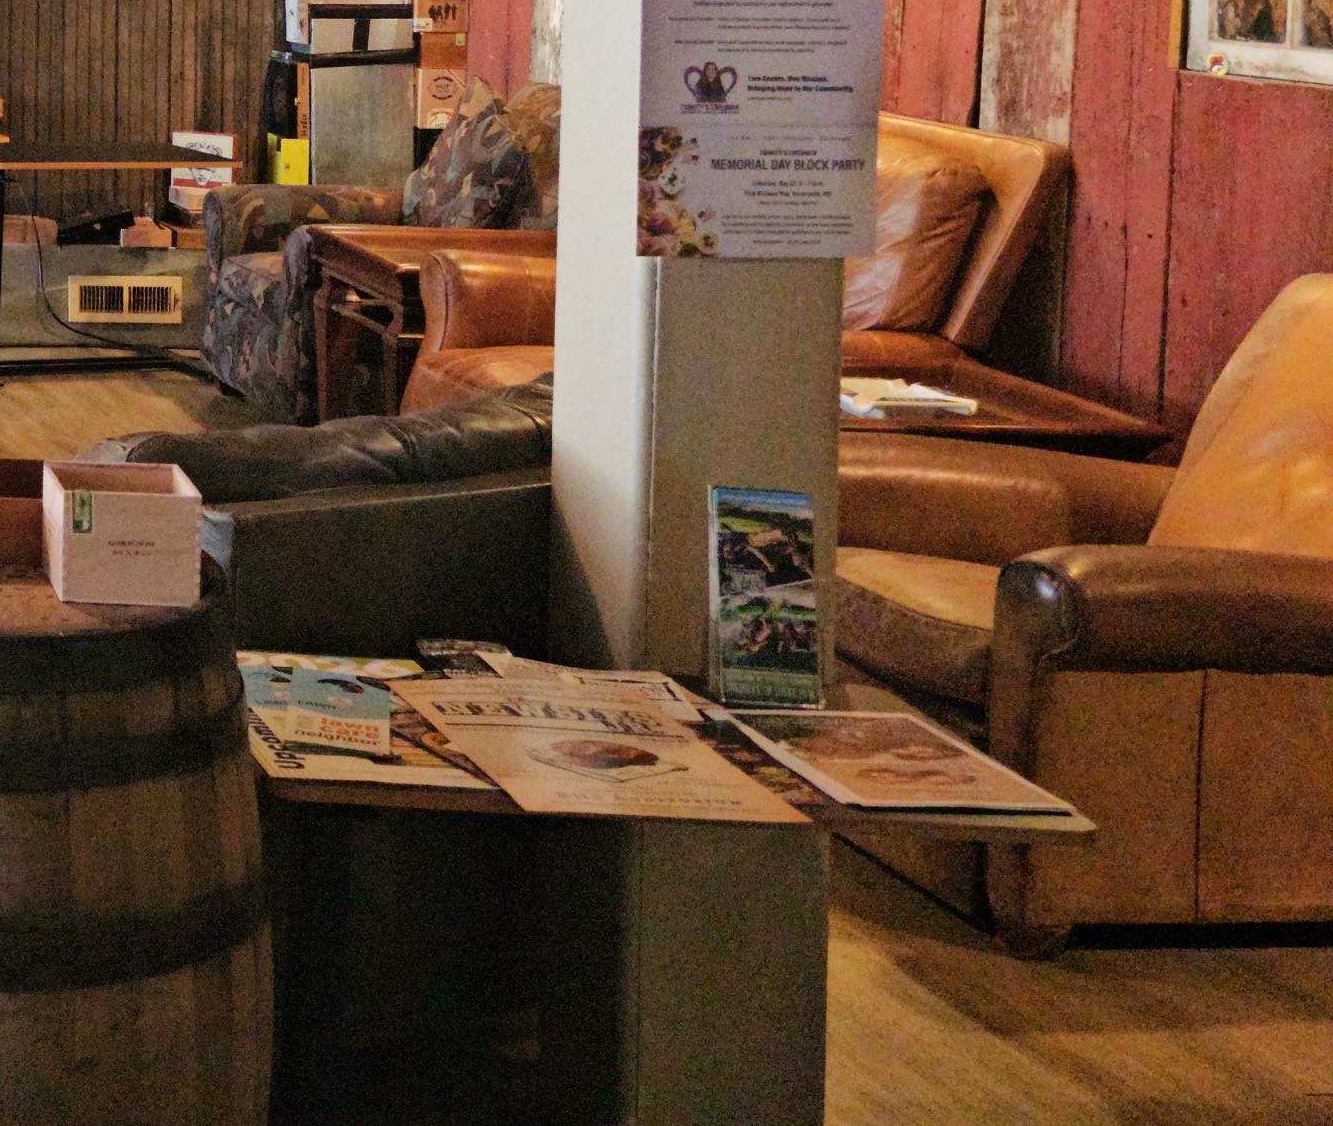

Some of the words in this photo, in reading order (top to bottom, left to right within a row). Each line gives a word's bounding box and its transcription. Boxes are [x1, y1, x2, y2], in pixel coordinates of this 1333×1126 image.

[710, 158, 767, 171] MEMORIAL
[771, 158, 791, 171] DAY
[794, 158, 829, 171] BLOCK
[832, 158, 866, 171] PARTY
[321, 717, 379, 733] lawn
[294, 729, 381, 747] neighbor
